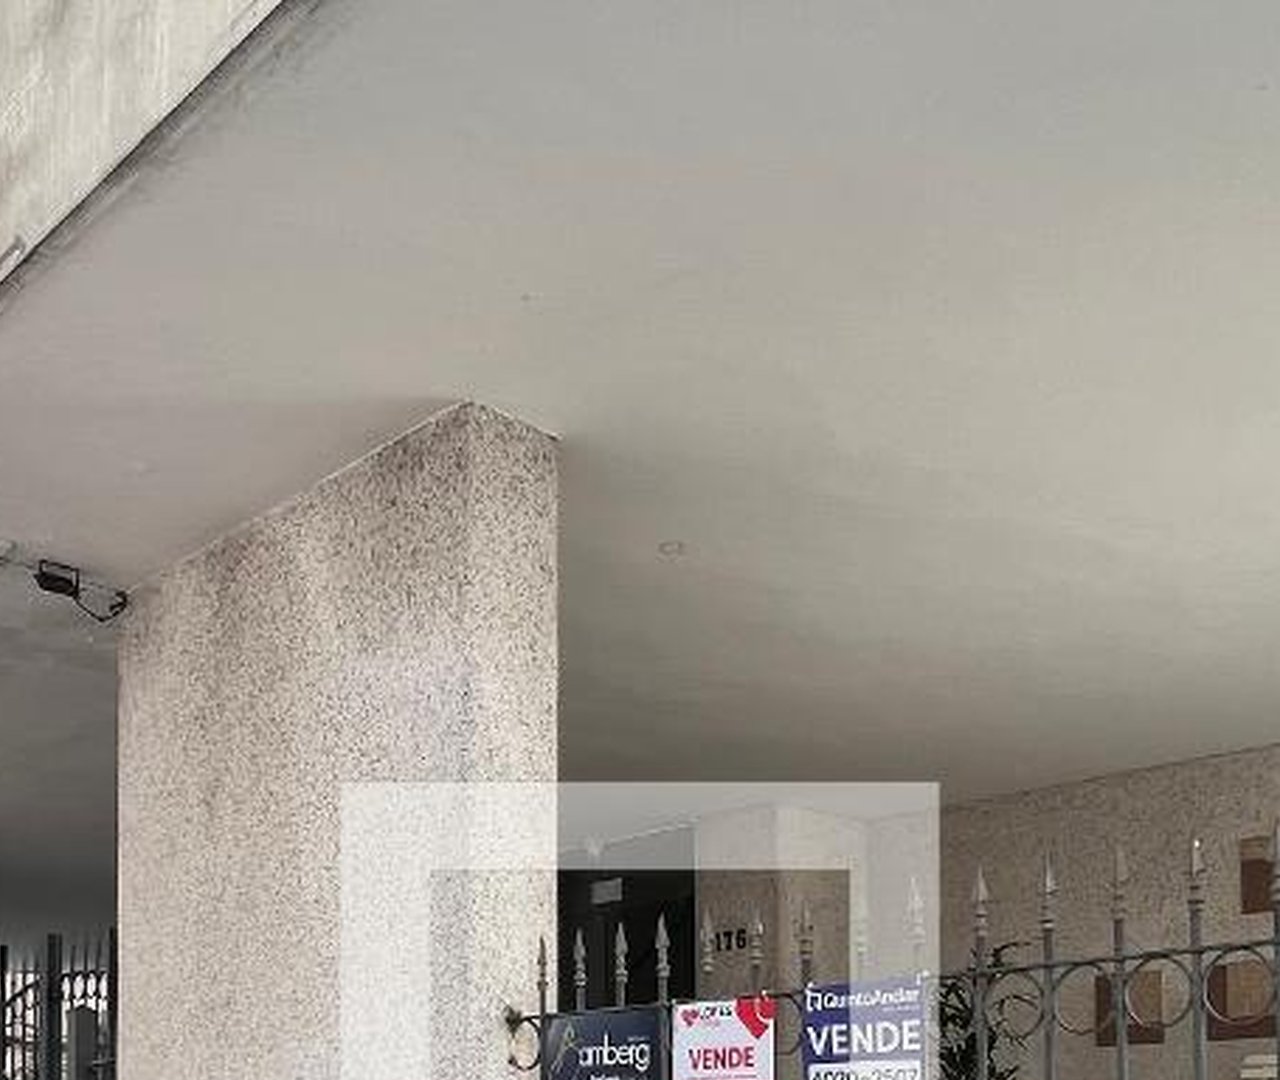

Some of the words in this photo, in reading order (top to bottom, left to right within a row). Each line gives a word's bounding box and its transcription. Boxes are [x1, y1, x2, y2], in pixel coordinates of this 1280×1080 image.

[715, 928, 746, 951] 176
[806, 1020, 921, 1055] VENDE
[687, 1046, 755, 1070] VENDE
